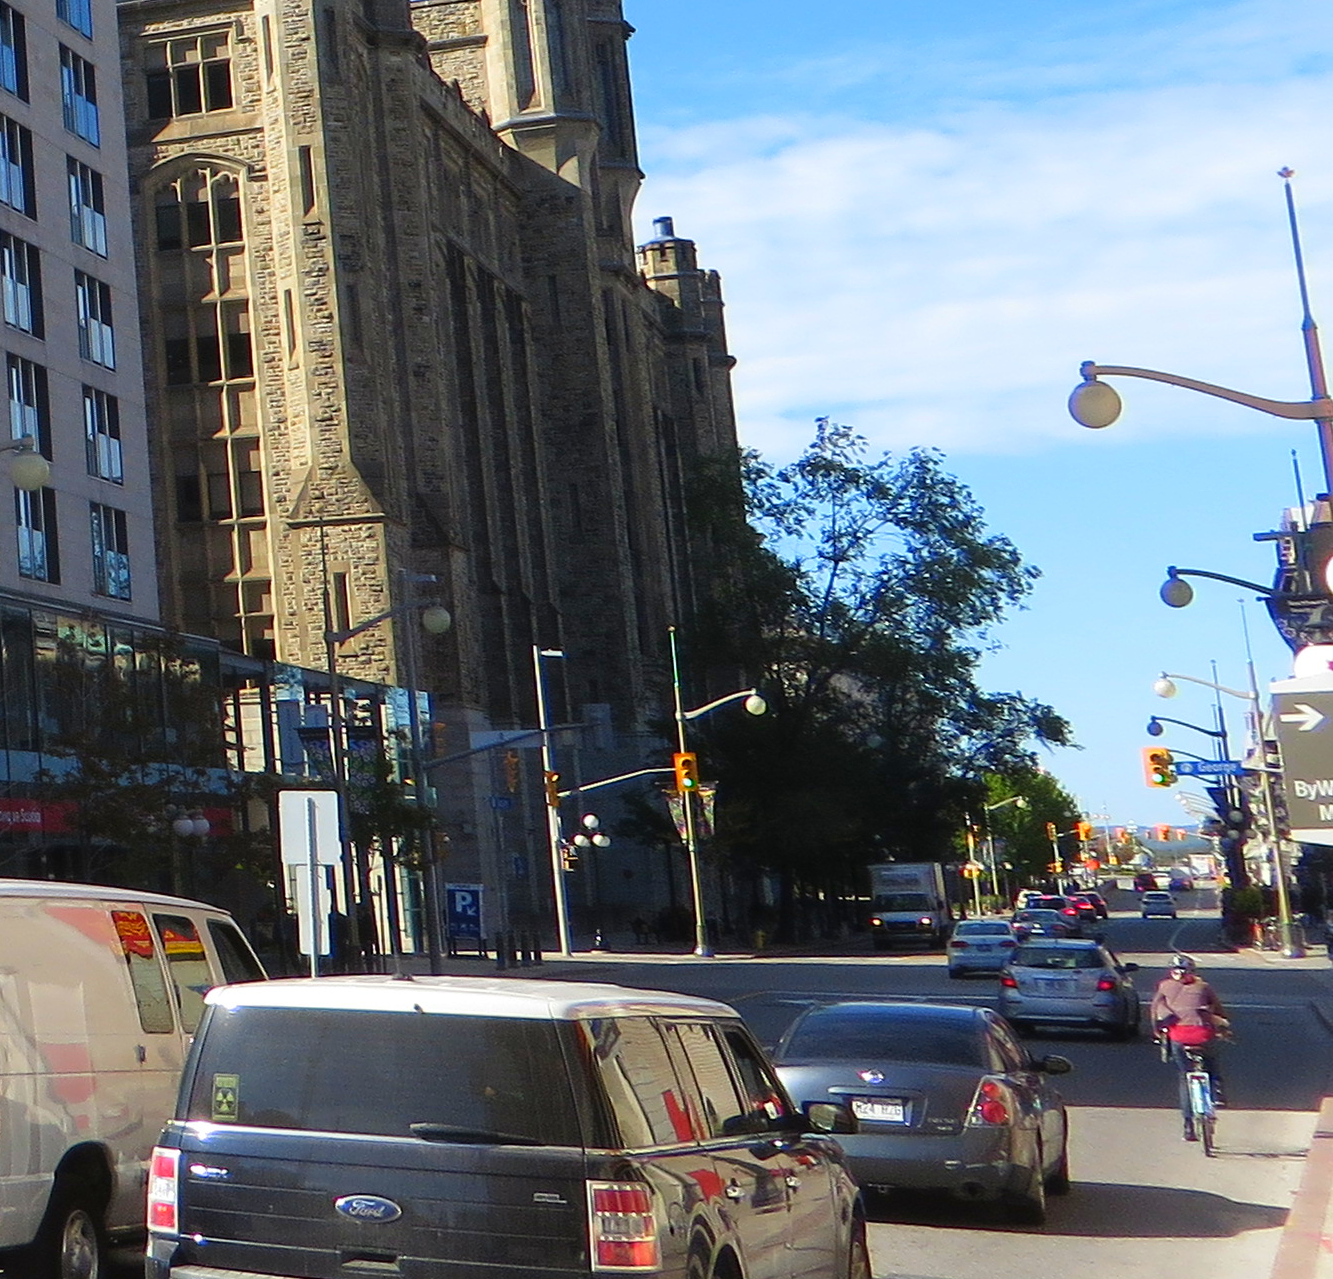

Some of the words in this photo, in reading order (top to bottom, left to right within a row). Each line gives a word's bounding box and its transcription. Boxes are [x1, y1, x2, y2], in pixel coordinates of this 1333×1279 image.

[1198, 760, 1237, 774] George
[455, 891, 473, 912] P
[349, 1199, 385, 1218] Ford
